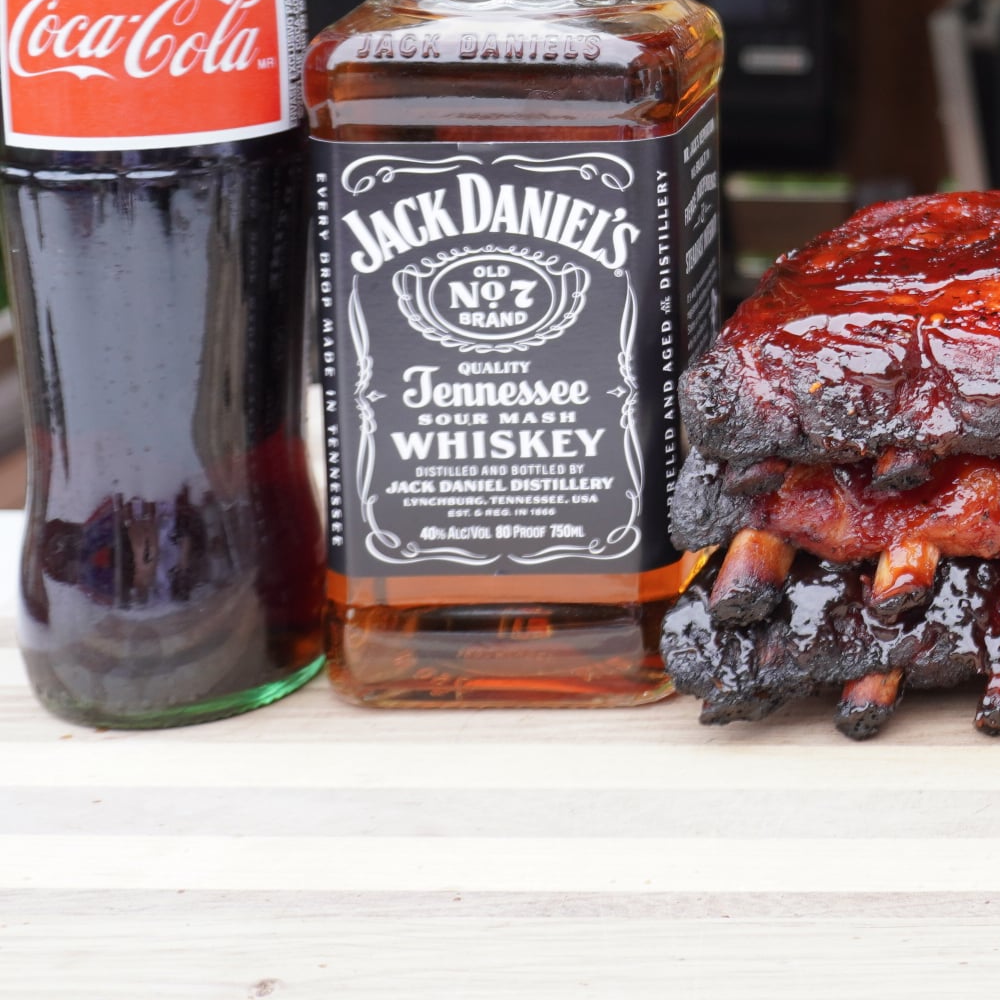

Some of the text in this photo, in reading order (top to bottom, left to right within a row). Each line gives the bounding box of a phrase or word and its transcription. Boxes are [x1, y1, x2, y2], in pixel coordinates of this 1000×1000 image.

[356, 33, 601, 61] JACK DANIEL'S
[341, 187, 457, 274] JACK
[456, 172, 641, 270] DANIEL'S
[656, 170, 671, 290] DISTILLERY
[473, 265, 510, 278] OLD
[459, 310, 528, 328] BRAND
[661, 320, 673, 372] AGED
[316, 172, 343, 547] EVERY DROP MADE IN TENNESSEE
[458, 361, 531, 376] QUALITY
[402, 365, 590, 409] Tennessee
[663, 380, 675, 420] AND
[417, 410, 577, 426] SOUR MASH
[390, 428, 606, 460] WHISKEY
[415, 463, 585, 477] DISTILLED AND BOTTLED BY
[385, 477, 615, 494] JACK DANIEL DISTILLERY
[572, 493, 599, 503] USA
[447, 509, 471, 518] EST.
[514, 508, 528, 516] IN
[419, 526, 447, 540] 40%
[495, 525, 511, 539] 80
